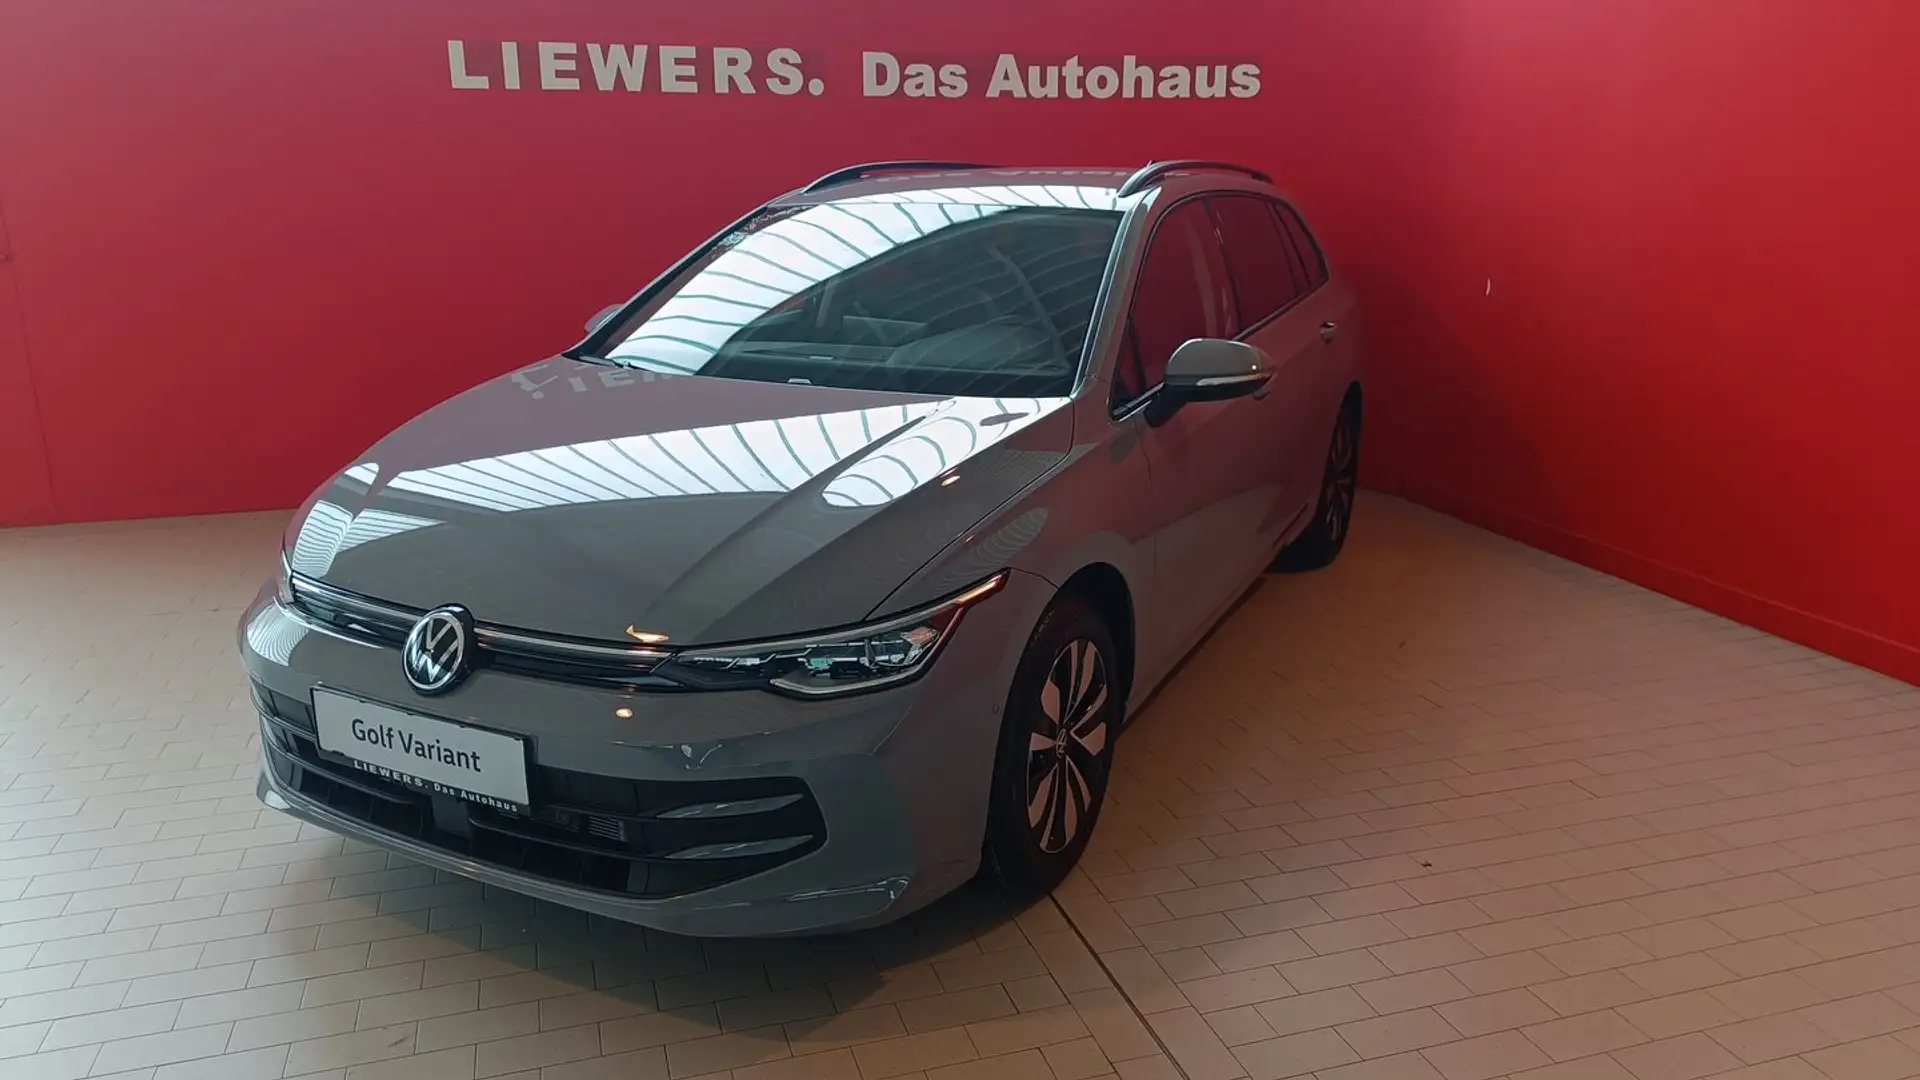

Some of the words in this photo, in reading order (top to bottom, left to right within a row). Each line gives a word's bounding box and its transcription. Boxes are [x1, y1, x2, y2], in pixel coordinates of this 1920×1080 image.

[448, 40, 825, 97] LIEWERS.
[863, 51, 968, 98] Das
[986, 53, 1260, 99] Autohaus
[352, 718, 393, 749] Golf
[398, 730, 482, 773] Variant
[353, 759, 429, 789] LIEWERS.
[433, 782, 455, 796] Das
[460, 790, 518, 812] Autohaus
